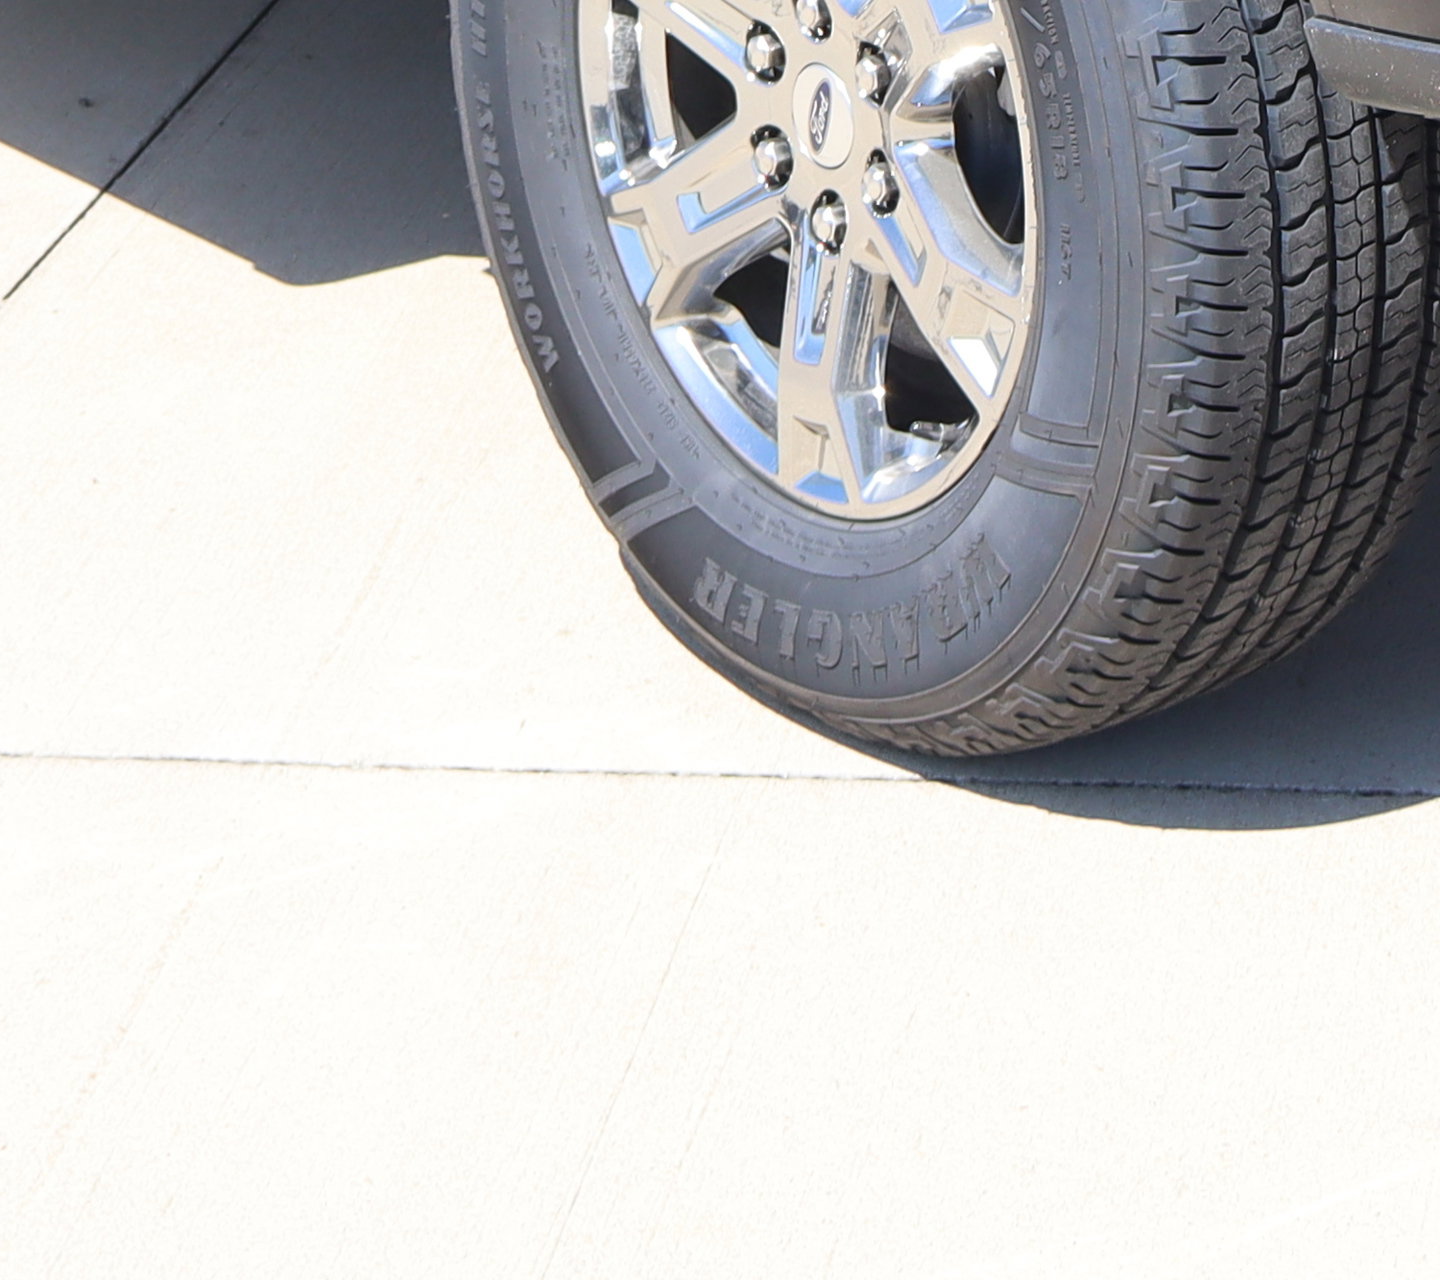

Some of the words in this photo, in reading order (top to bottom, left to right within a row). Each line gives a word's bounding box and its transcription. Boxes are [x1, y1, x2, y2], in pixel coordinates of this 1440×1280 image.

[810, 90, 829, 145] Ford
[475, 81, 559, 374] WORKHORSE
[690, 530, 1012, 671] WRANGLER
